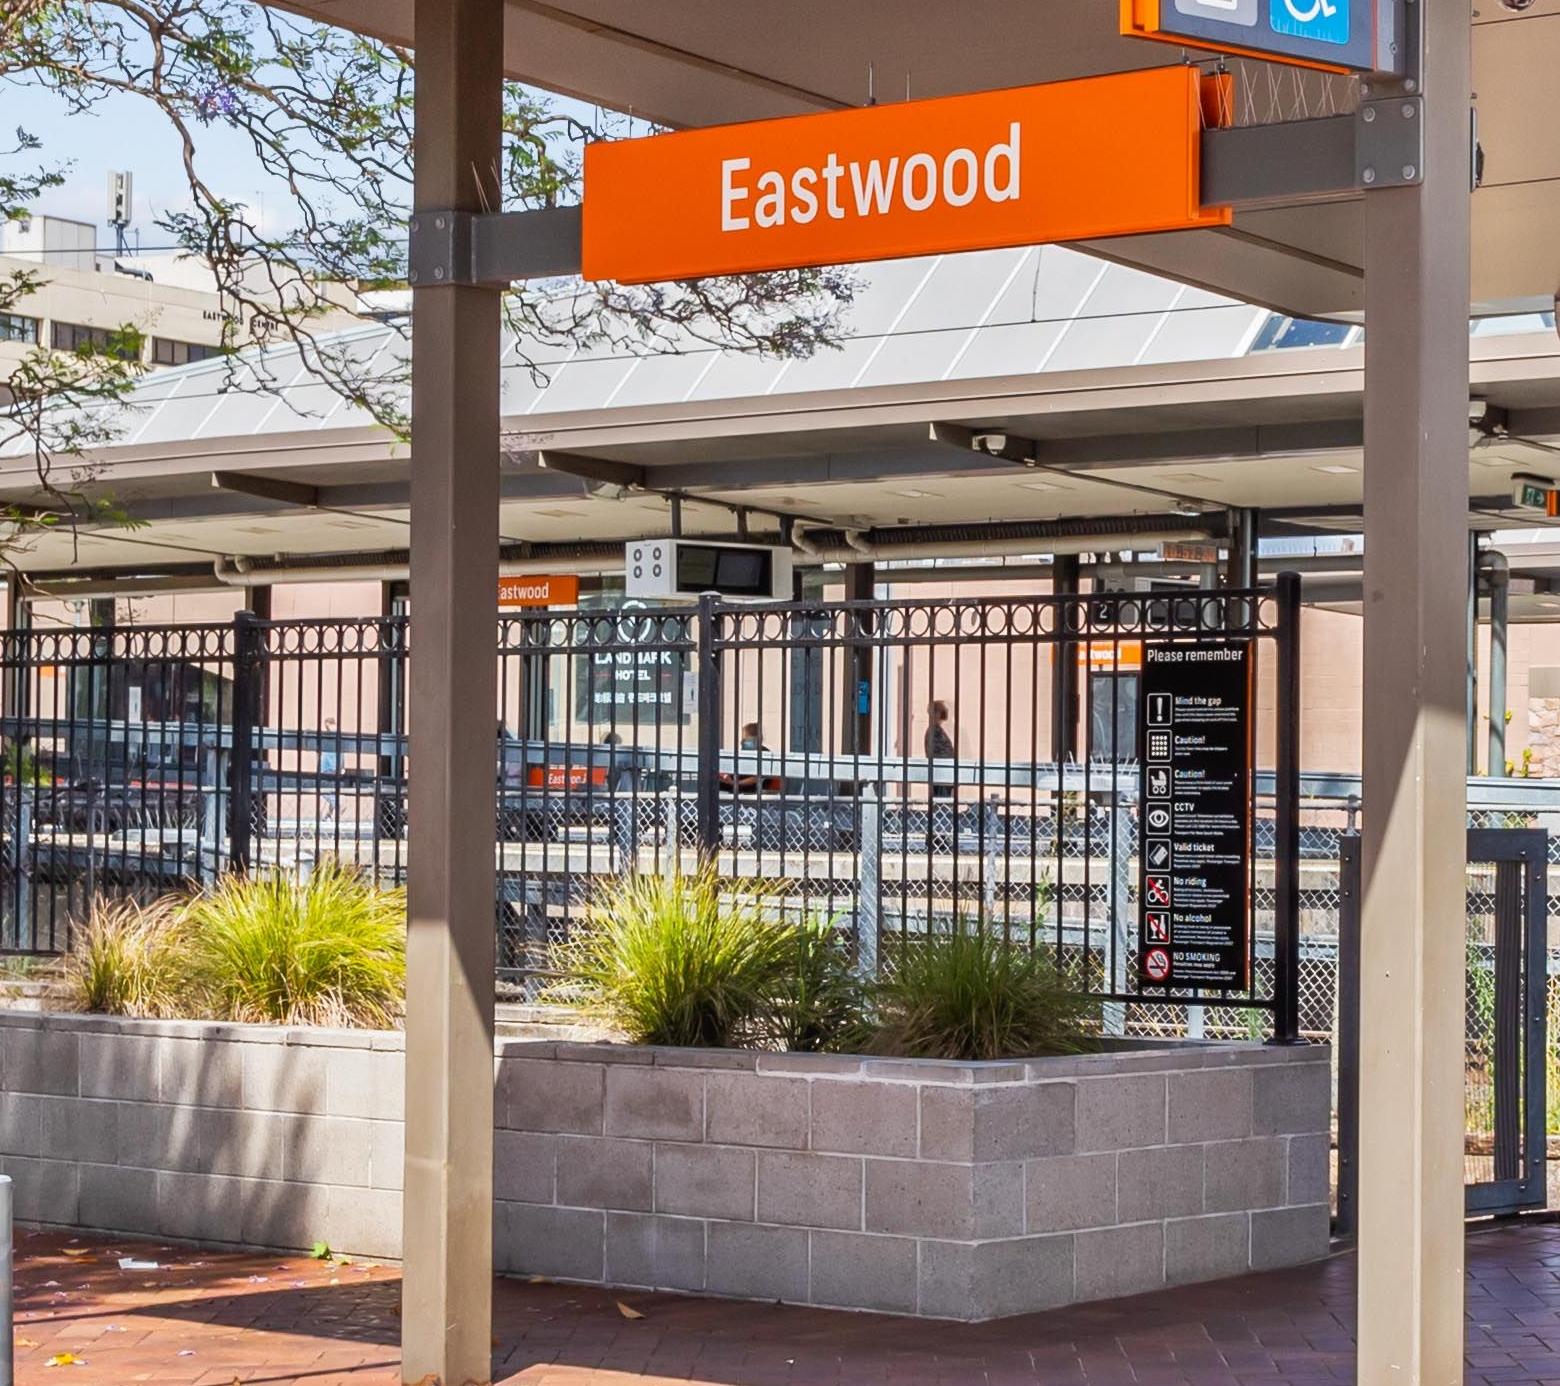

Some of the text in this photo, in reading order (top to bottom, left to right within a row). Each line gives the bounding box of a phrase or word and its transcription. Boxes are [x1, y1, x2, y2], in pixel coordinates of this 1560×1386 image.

[721, 121, 1020, 231] Eastwood
[498, 582, 549, 600] astwood
[1099, 604, 1108, 619] 2
[594, 651, 672, 665] LANDARK
[1147, 647, 1243, 662] Please remember
[1175, 696, 1222, 707] Mind the gap
[1174, 735, 1205, 744] Caution!
[548, 773, 588, 784] Eastood
[1174, 769, 1205, 778] Caution!
[1174, 802, 1195, 811] CCTV
[1173, 842, 1215, 852] Valid ticket
[1173, 876, 1207, 887] No riding
[1173, 913, 1212, 922] No alcohol
[1173, 952, 1220, 962] NO SMOKING
